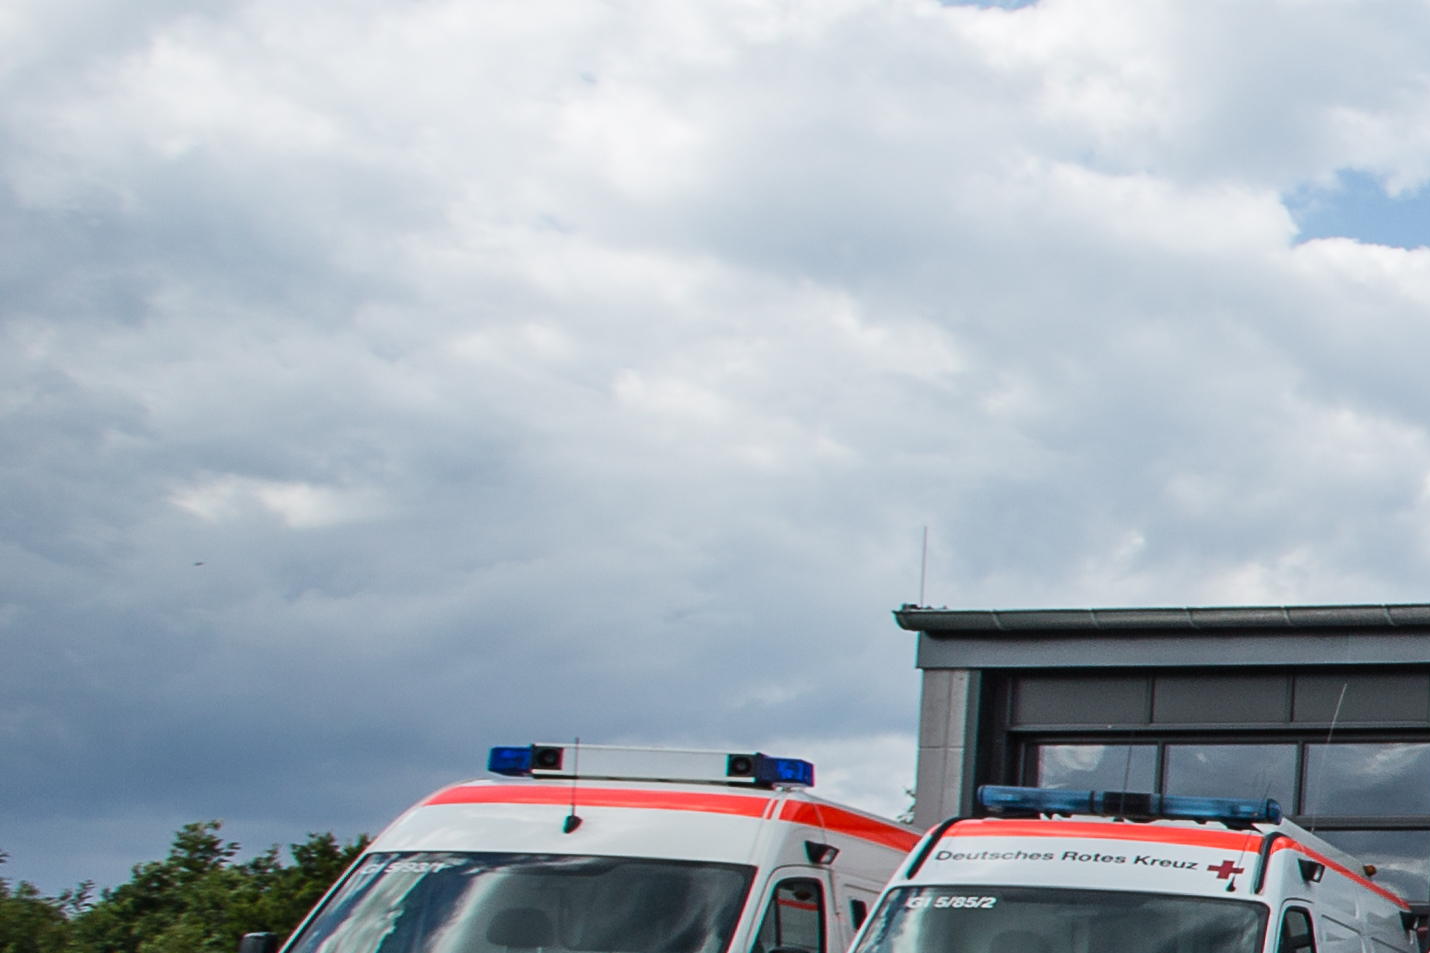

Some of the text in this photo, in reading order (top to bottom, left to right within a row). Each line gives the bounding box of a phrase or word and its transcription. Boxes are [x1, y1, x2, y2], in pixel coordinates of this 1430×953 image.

[935, 850, 1198, 870] Deutsches Rotes Kreuz
[907, 896, 997, 909] GI 5/85/2
